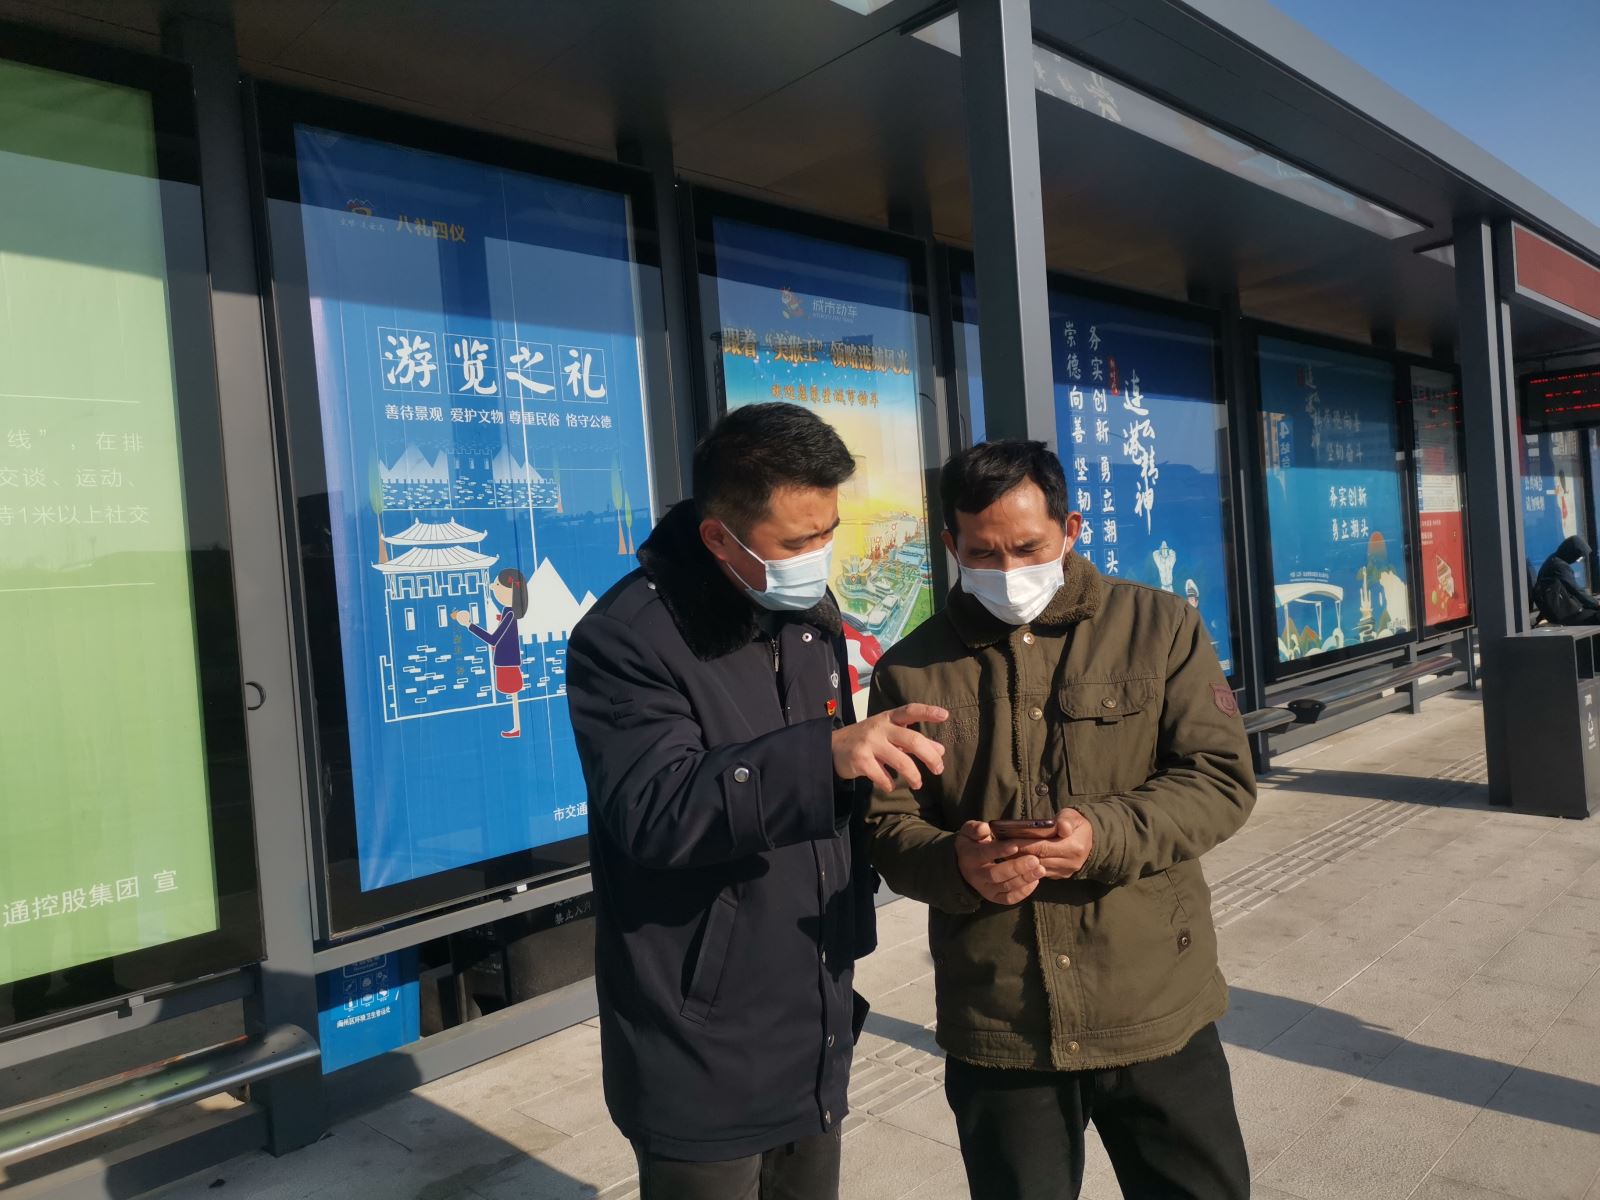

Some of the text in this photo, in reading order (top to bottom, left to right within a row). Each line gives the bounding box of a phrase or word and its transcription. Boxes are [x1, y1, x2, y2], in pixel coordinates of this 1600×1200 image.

[396, 215, 466, 243] 八礼四仪
[812, 299, 858, 319] 城市动车
[384, 334, 607, 399] 游览之礼
[1064, 320, 1086, 444] 崇德向善
[384, 403, 613, 430] 善待景观 爱护文物 尊重民俗 恪守公德
[1088, 325, 1119, 575] 务实创新 勇立潮头
[1122, 368, 1160, 537] 连云港精神
[1329, 486, 1368, 508] 务实创新
[1331, 518, 1370, 542] 勇立潮头
[552, 801, 588, 822] 市交通
[2, 869, 179, 928] 通控股集团 宣
